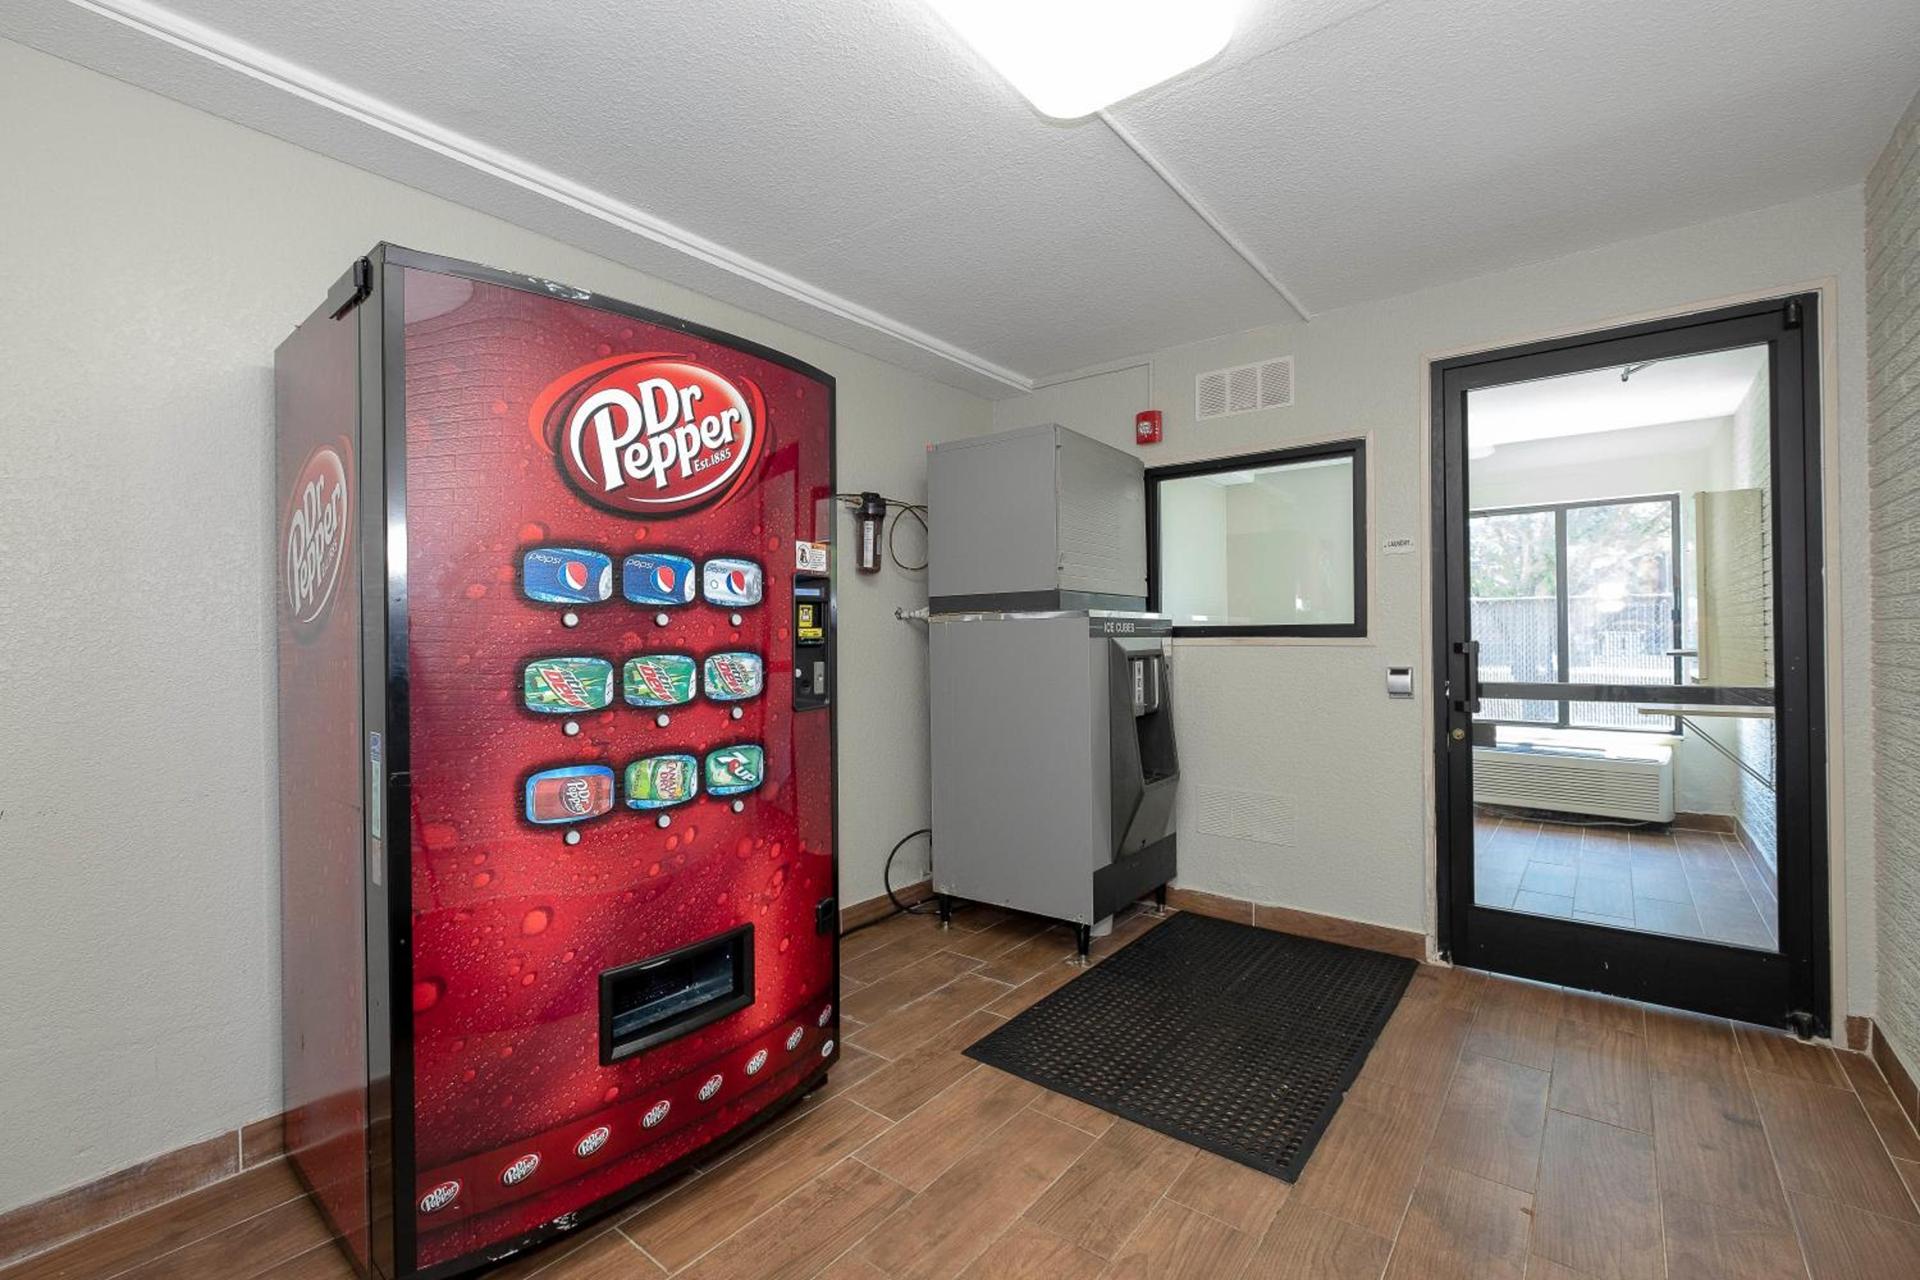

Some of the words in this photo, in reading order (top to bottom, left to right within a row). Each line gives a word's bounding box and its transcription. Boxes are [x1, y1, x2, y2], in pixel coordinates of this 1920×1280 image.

[638, 378, 702, 435] Dr
[570, 388, 741, 491] Pepper
[303, 474, 324, 546] Dr
[288, 483, 340, 616] Pepper
[528, 552, 561, 564] pepsi
[625, 558, 654, 569] pepsi
[1103, 622, 1114, 633] ICE
[1115, 622, 1135, 633] CUBES
[566, 778, 588, 812] Pepper
[579, 790, 590, 804] Dr
